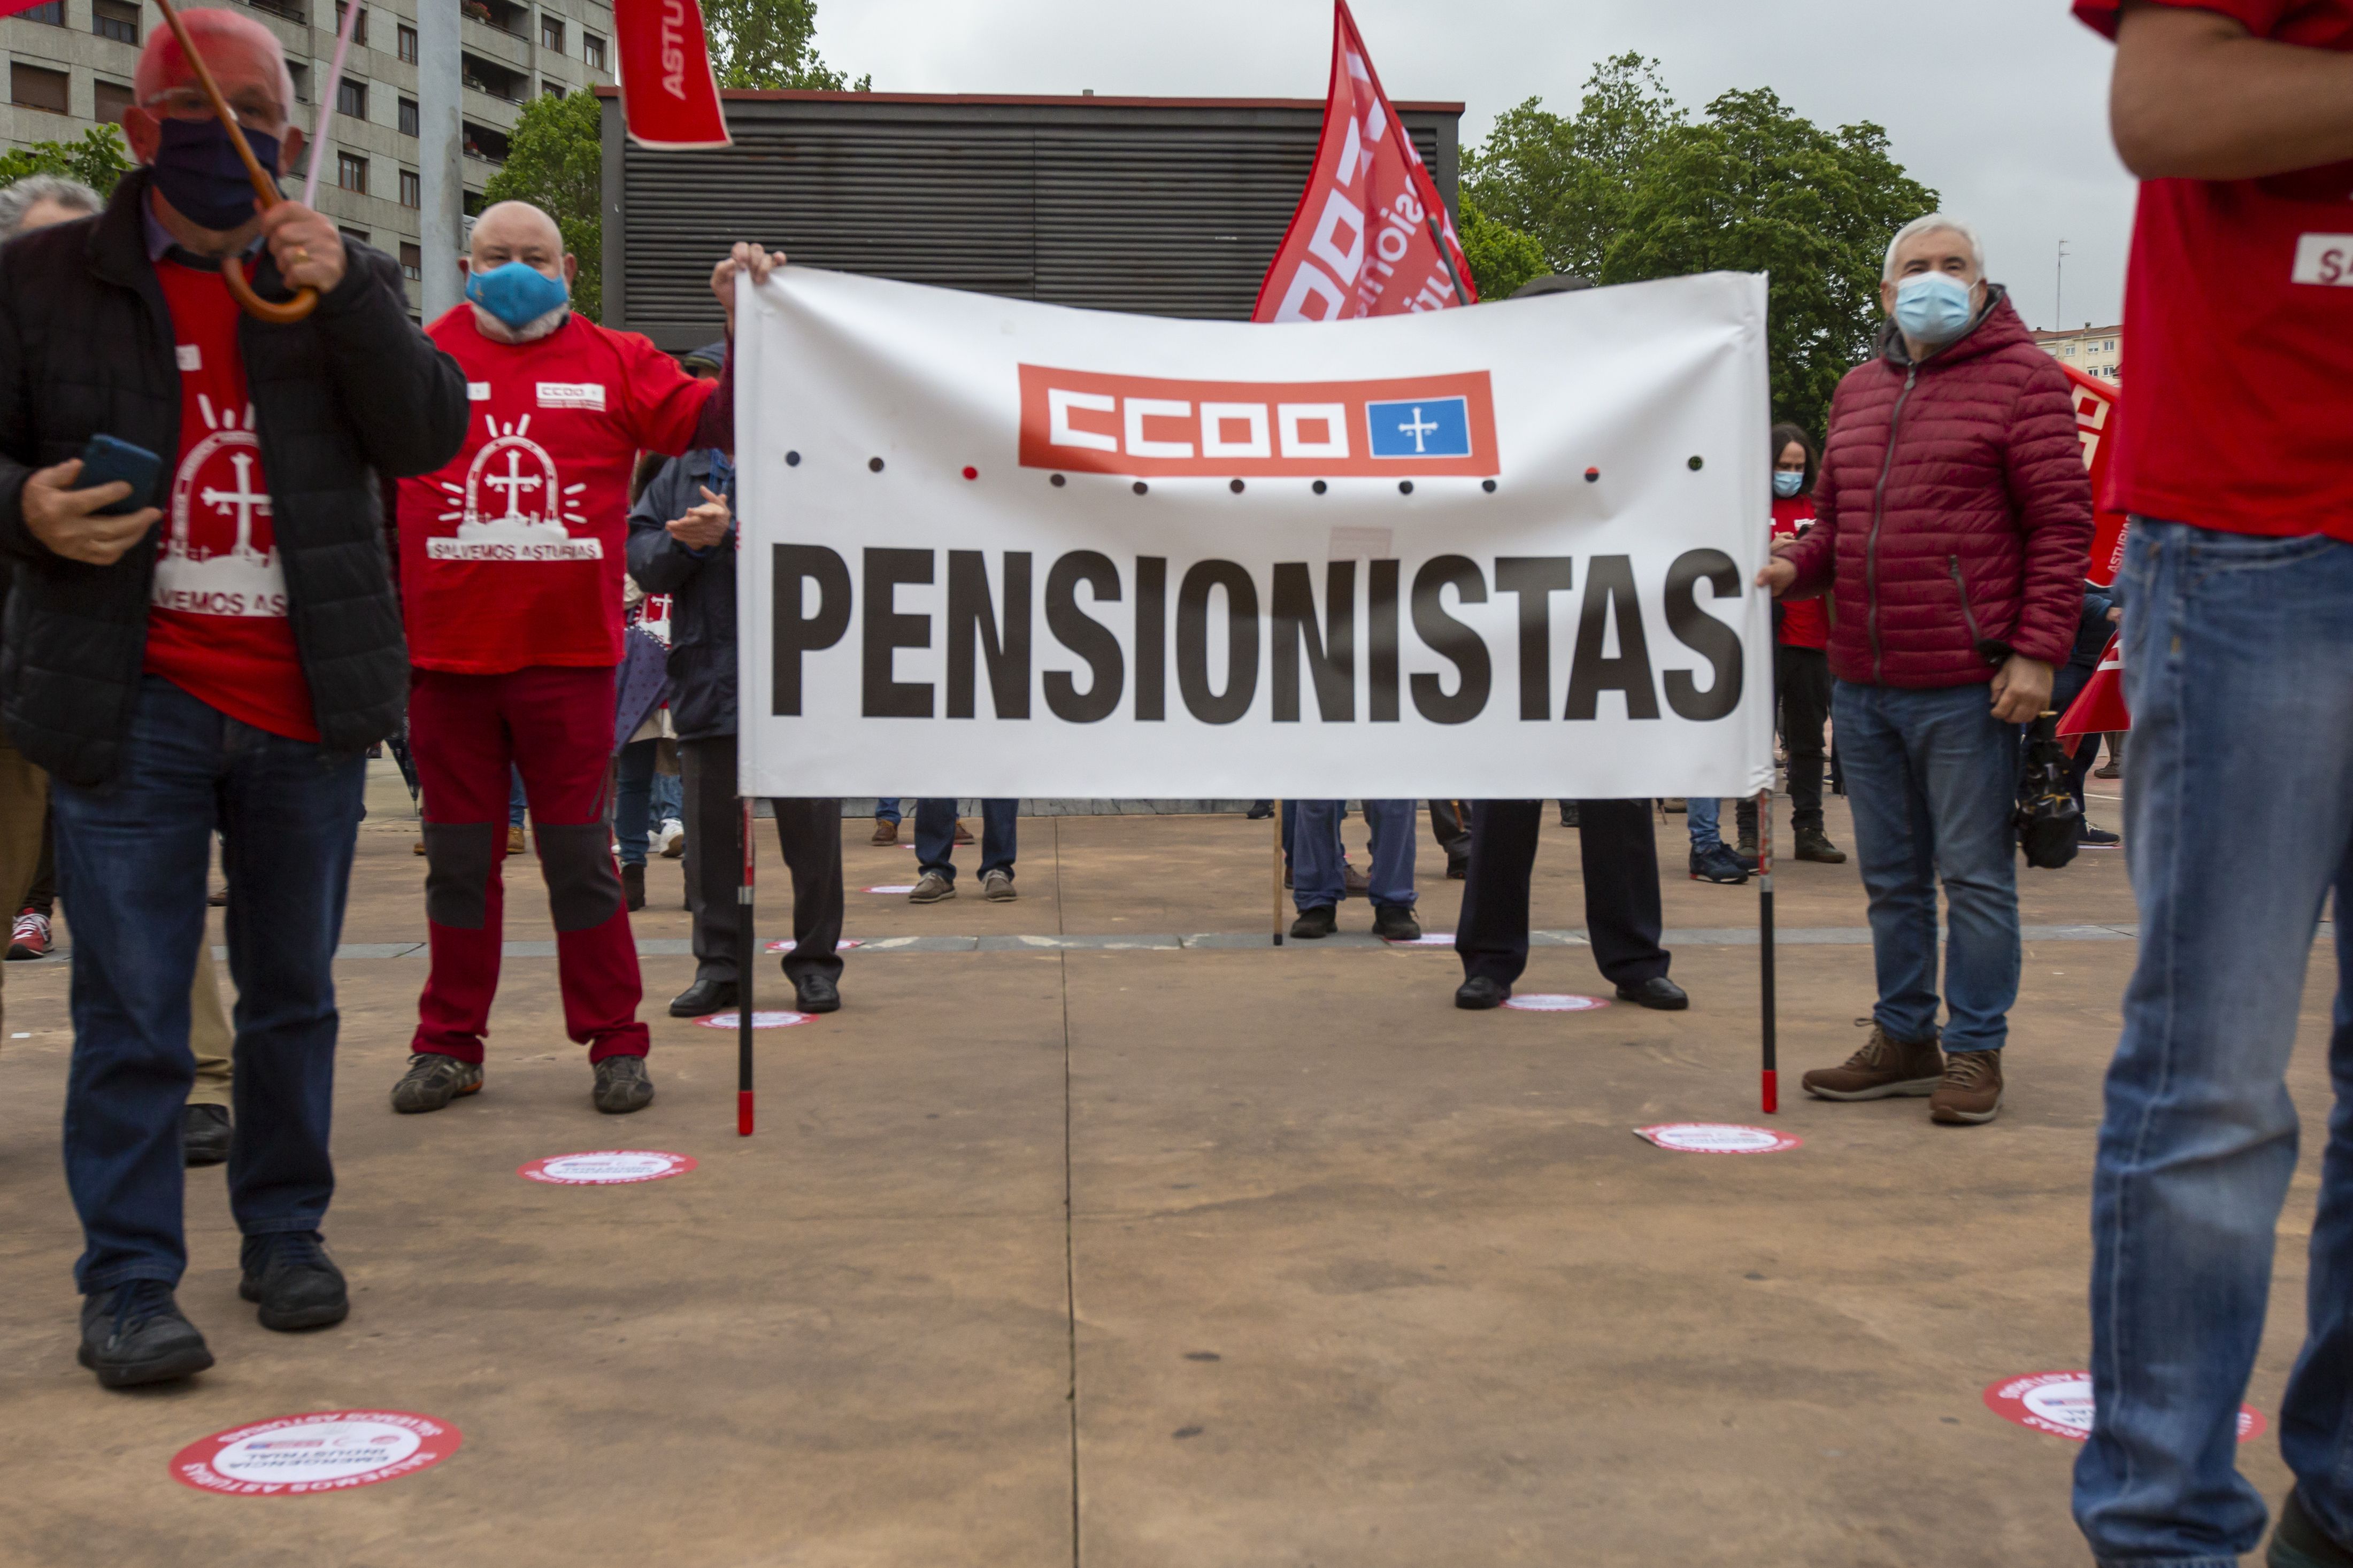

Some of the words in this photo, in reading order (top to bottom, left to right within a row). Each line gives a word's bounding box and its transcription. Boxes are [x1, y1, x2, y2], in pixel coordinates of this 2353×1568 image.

[2319, 248, 2353, 284] S
[1048, 388, 1350, 459] CCOO
[434, 542, 517, 559] SALVEMOS
[521, 543, 597, 560] ASTURIAS
[771, 543, 1743, 725] PENSIONISTAS
